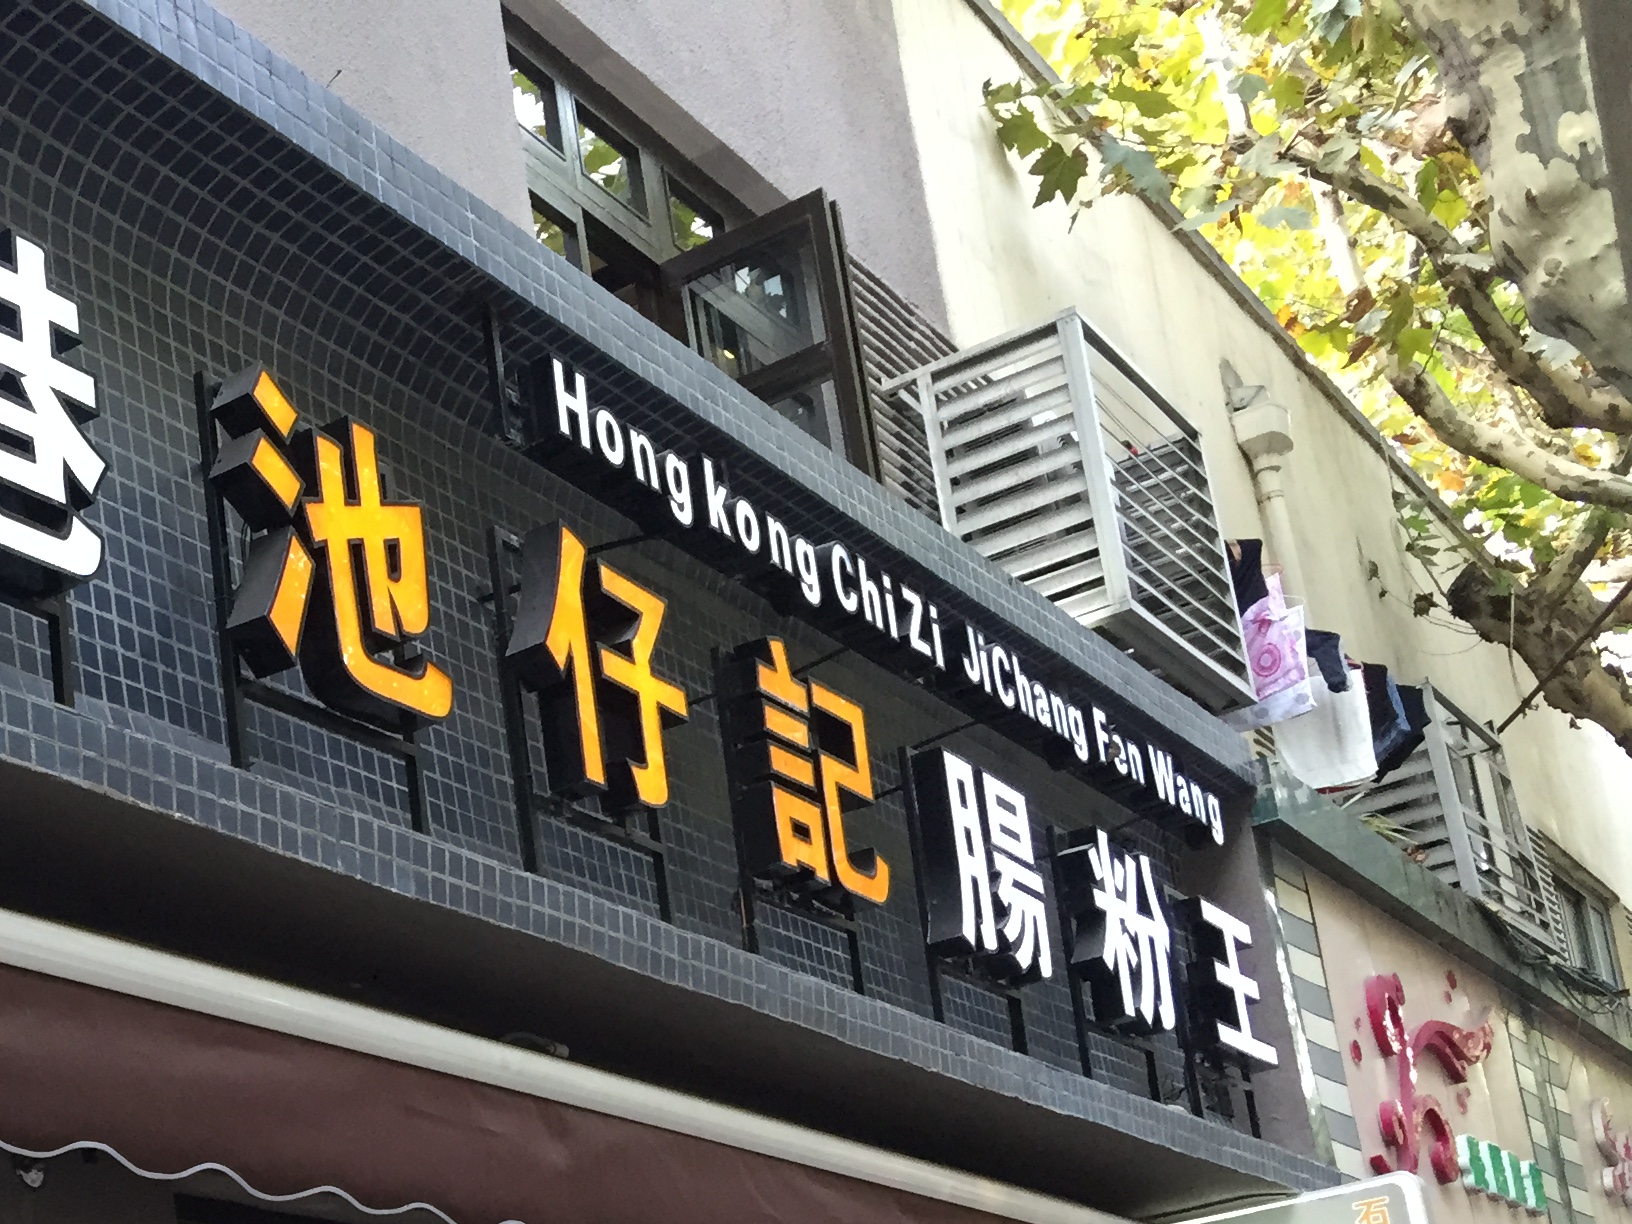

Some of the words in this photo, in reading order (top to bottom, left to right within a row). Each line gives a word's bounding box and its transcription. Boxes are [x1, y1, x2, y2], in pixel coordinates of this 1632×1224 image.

[552, 357, 694, 527] Hong
[703, 455, 821, 607] kong
[1147, 742, 1224, 846] Wang
